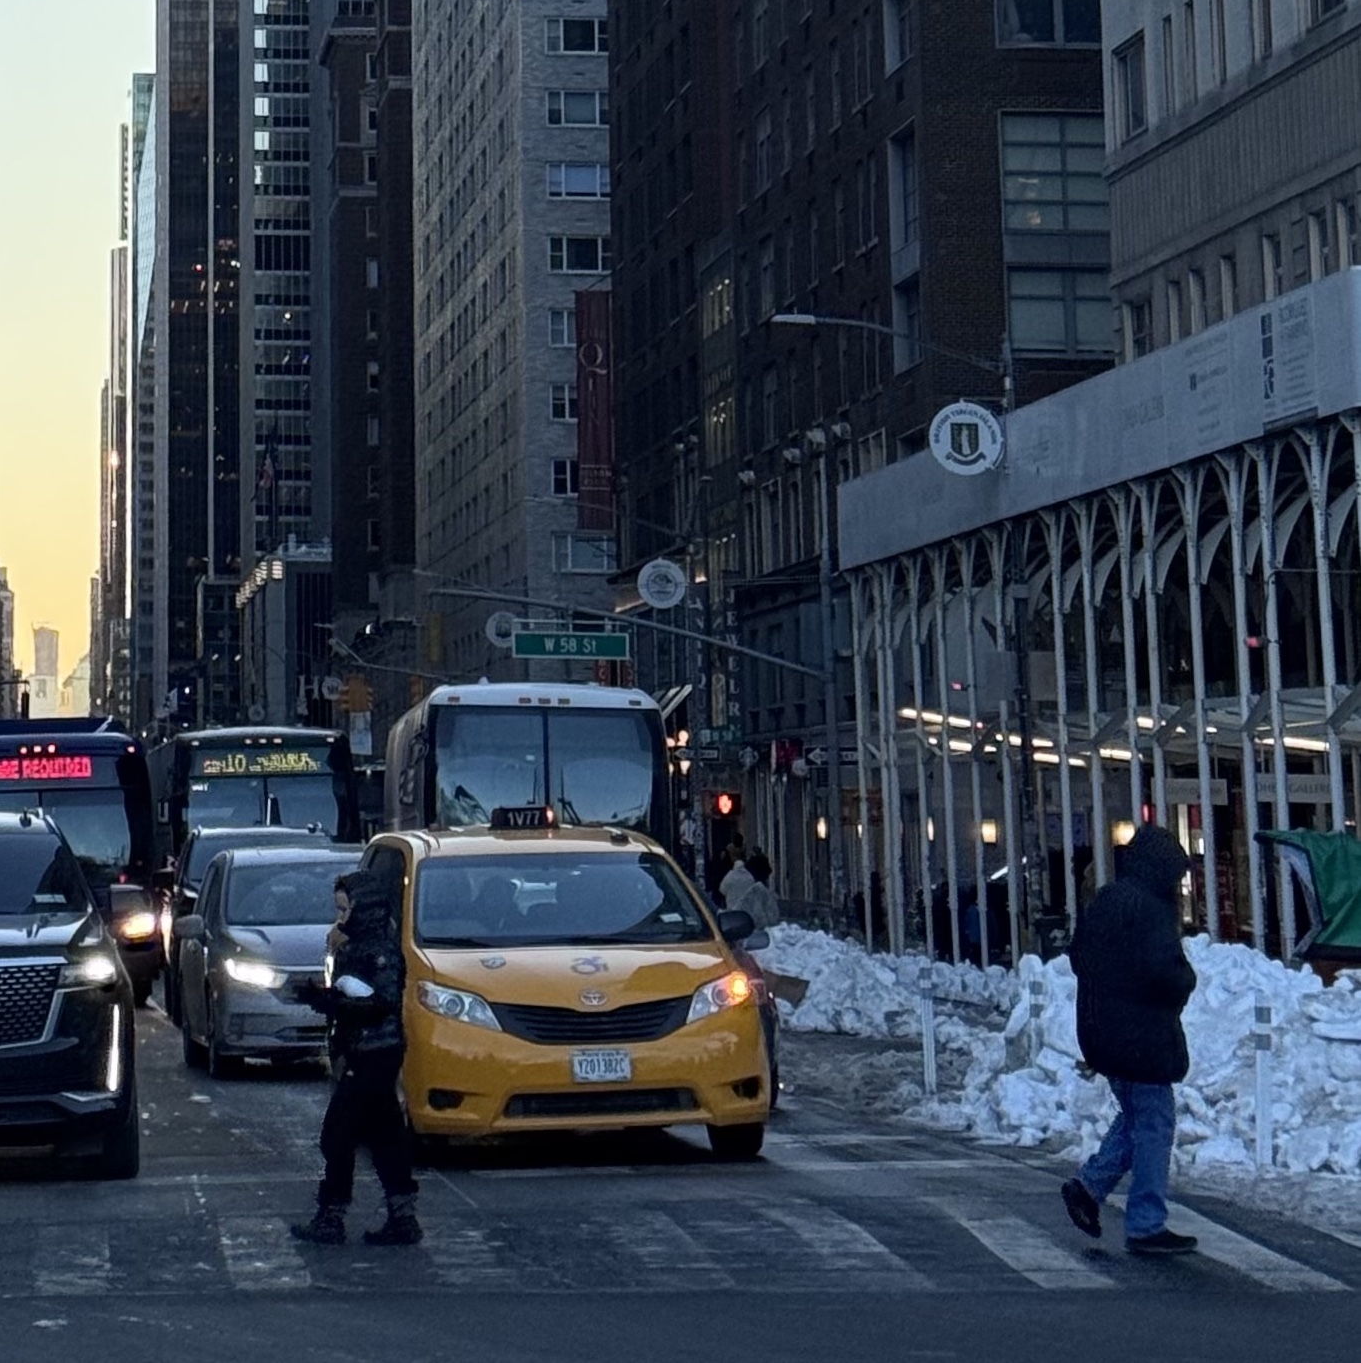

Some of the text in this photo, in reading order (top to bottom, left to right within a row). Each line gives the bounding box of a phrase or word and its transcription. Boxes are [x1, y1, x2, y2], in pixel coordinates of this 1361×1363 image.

[543, 637, 597, 653] W 58 St
[507, 811, 541, 827] 1V77
